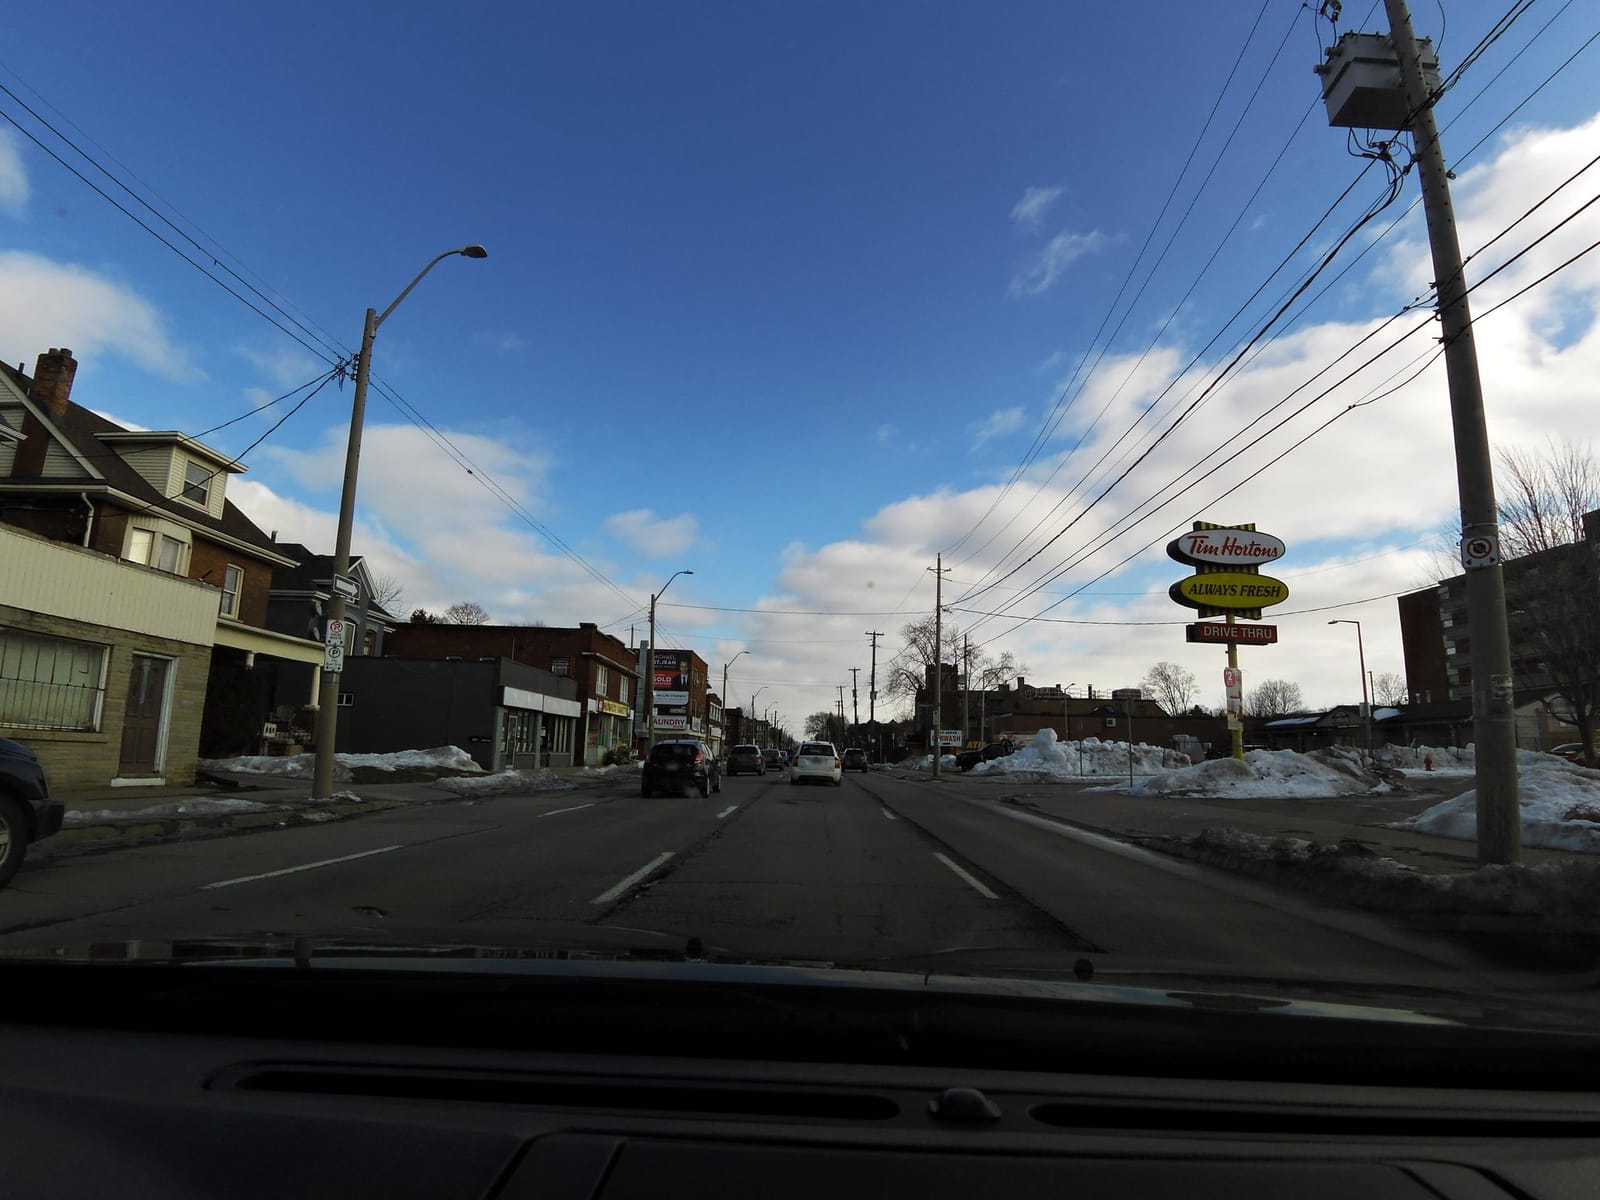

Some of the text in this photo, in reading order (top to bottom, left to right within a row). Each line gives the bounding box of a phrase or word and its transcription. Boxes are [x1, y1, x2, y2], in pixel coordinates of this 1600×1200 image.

[1188, 535, 1279, 557] Tim Hortons
[1189, 583, 1281, 597] ALWAYS FRESH
[1203, 626, 1272, 639] DRIVE THRU
[653, 718, 685, 726] AUNDRY
